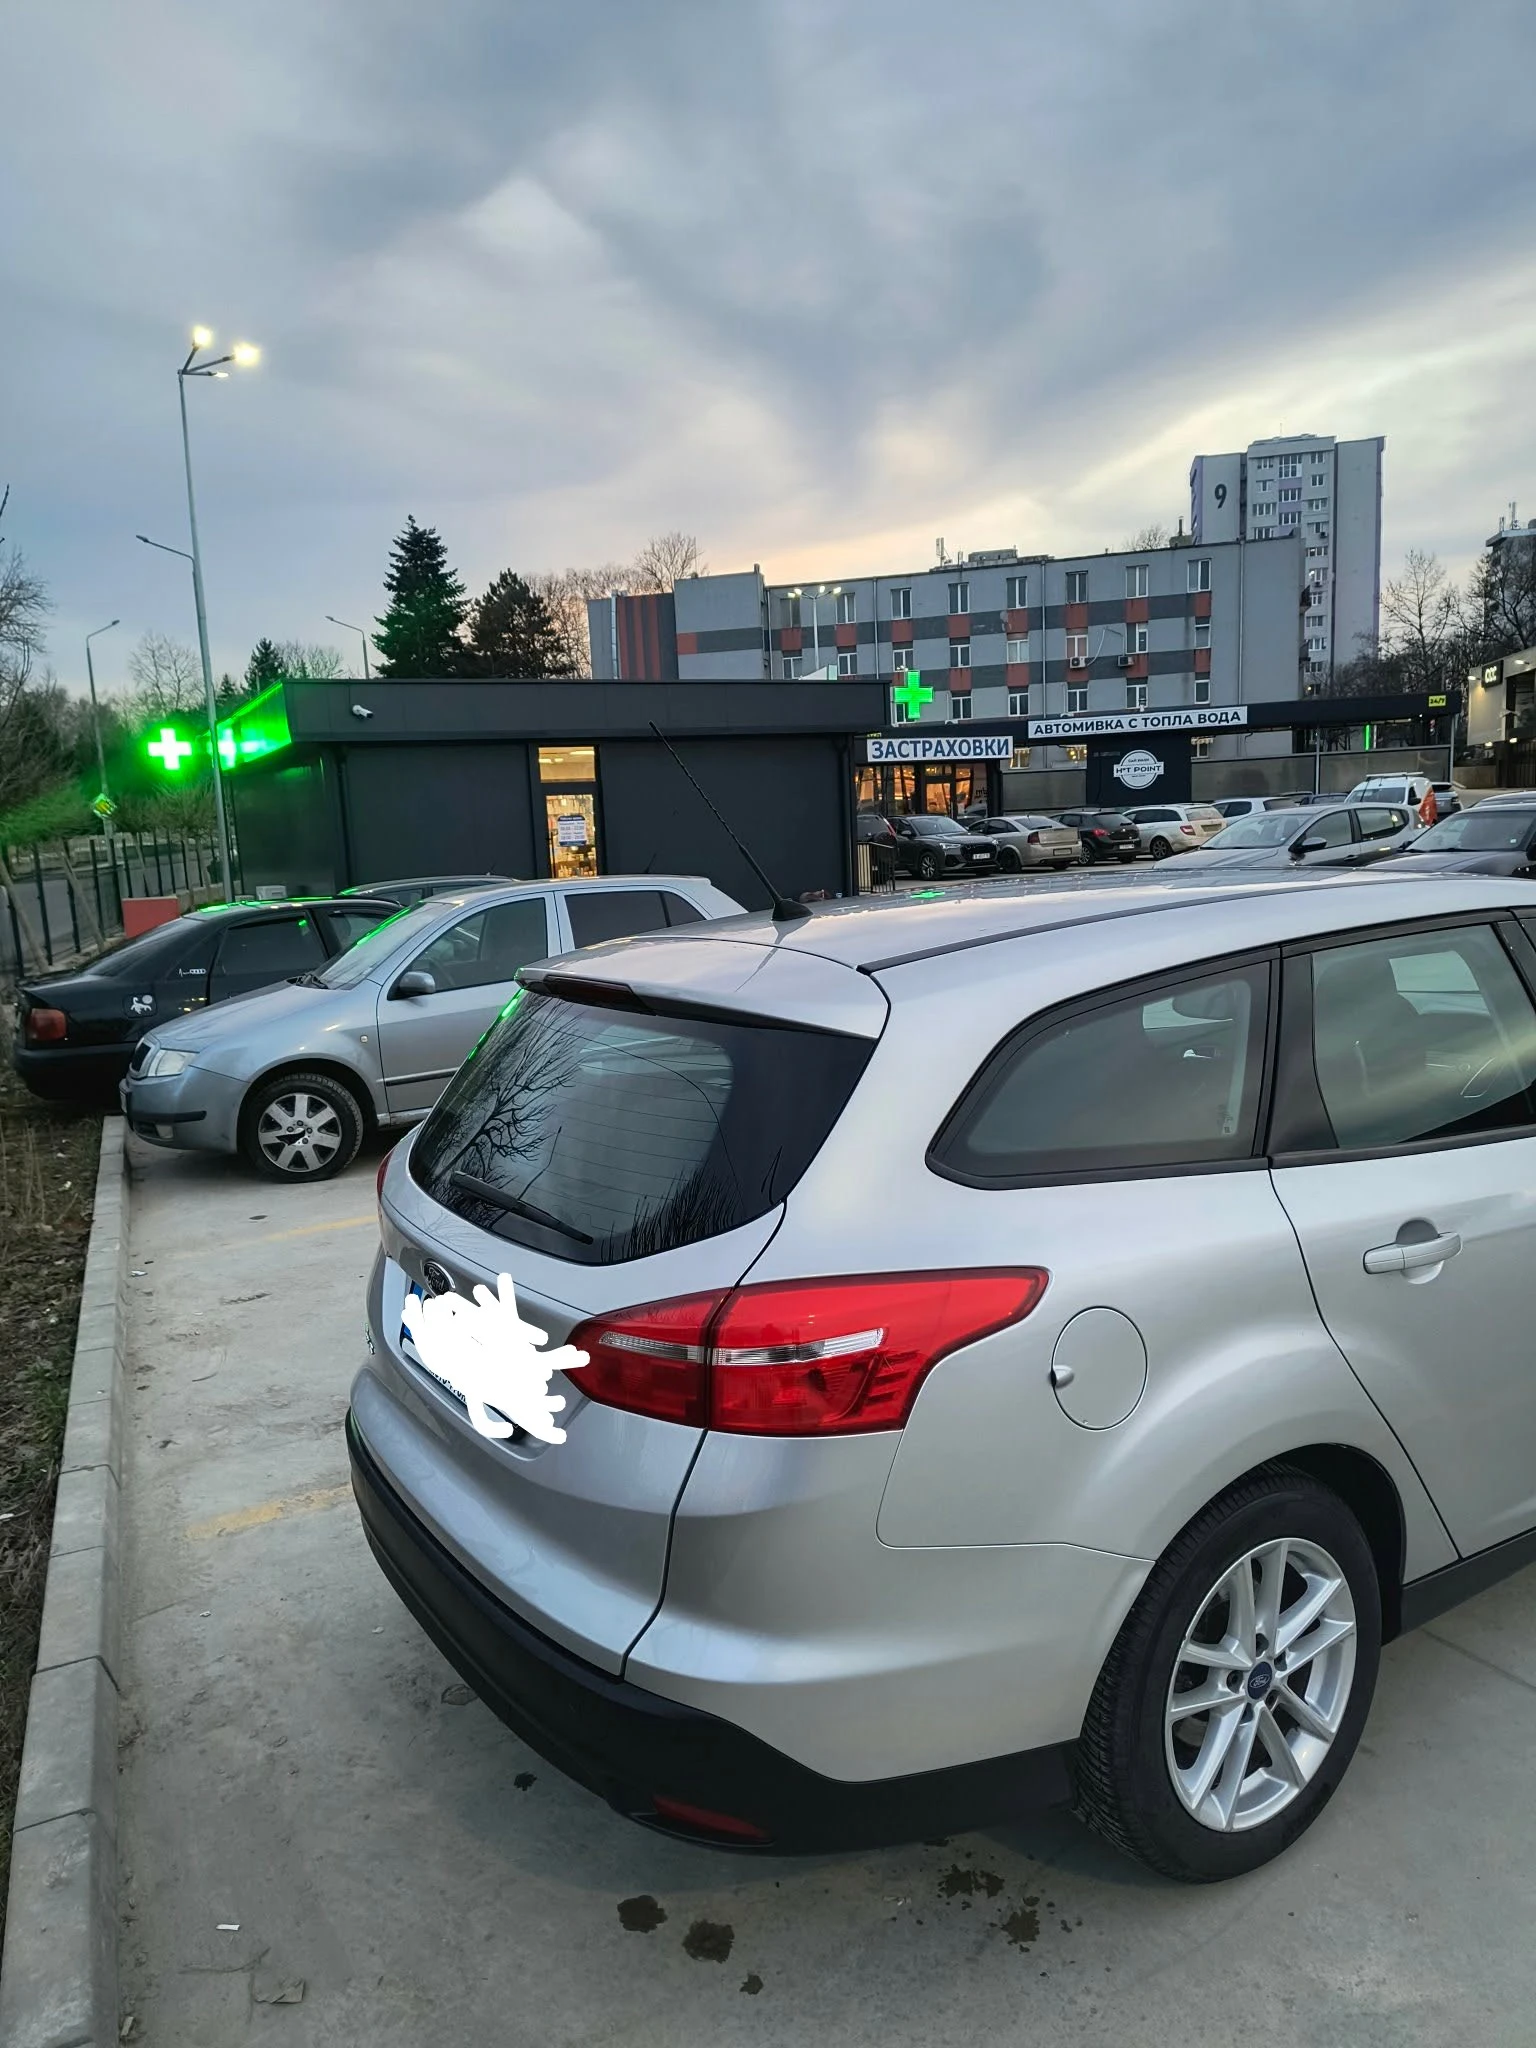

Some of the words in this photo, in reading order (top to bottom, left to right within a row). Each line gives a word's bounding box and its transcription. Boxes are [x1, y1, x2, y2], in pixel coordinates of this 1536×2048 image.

[1214, 483, 1227, 508] 9
[1034, 719, 1124, 735] АВТОМИВКА
[1128, 718, 1138, 728] С
[1142, 714, 1193, 727] ТОПЛА
[1198, 711, 1241, 725] ВОДА
[871, 738, 1010, 759] ЗАСТРАХОВКИ
[427, 1267, 445, 1291] Ford
